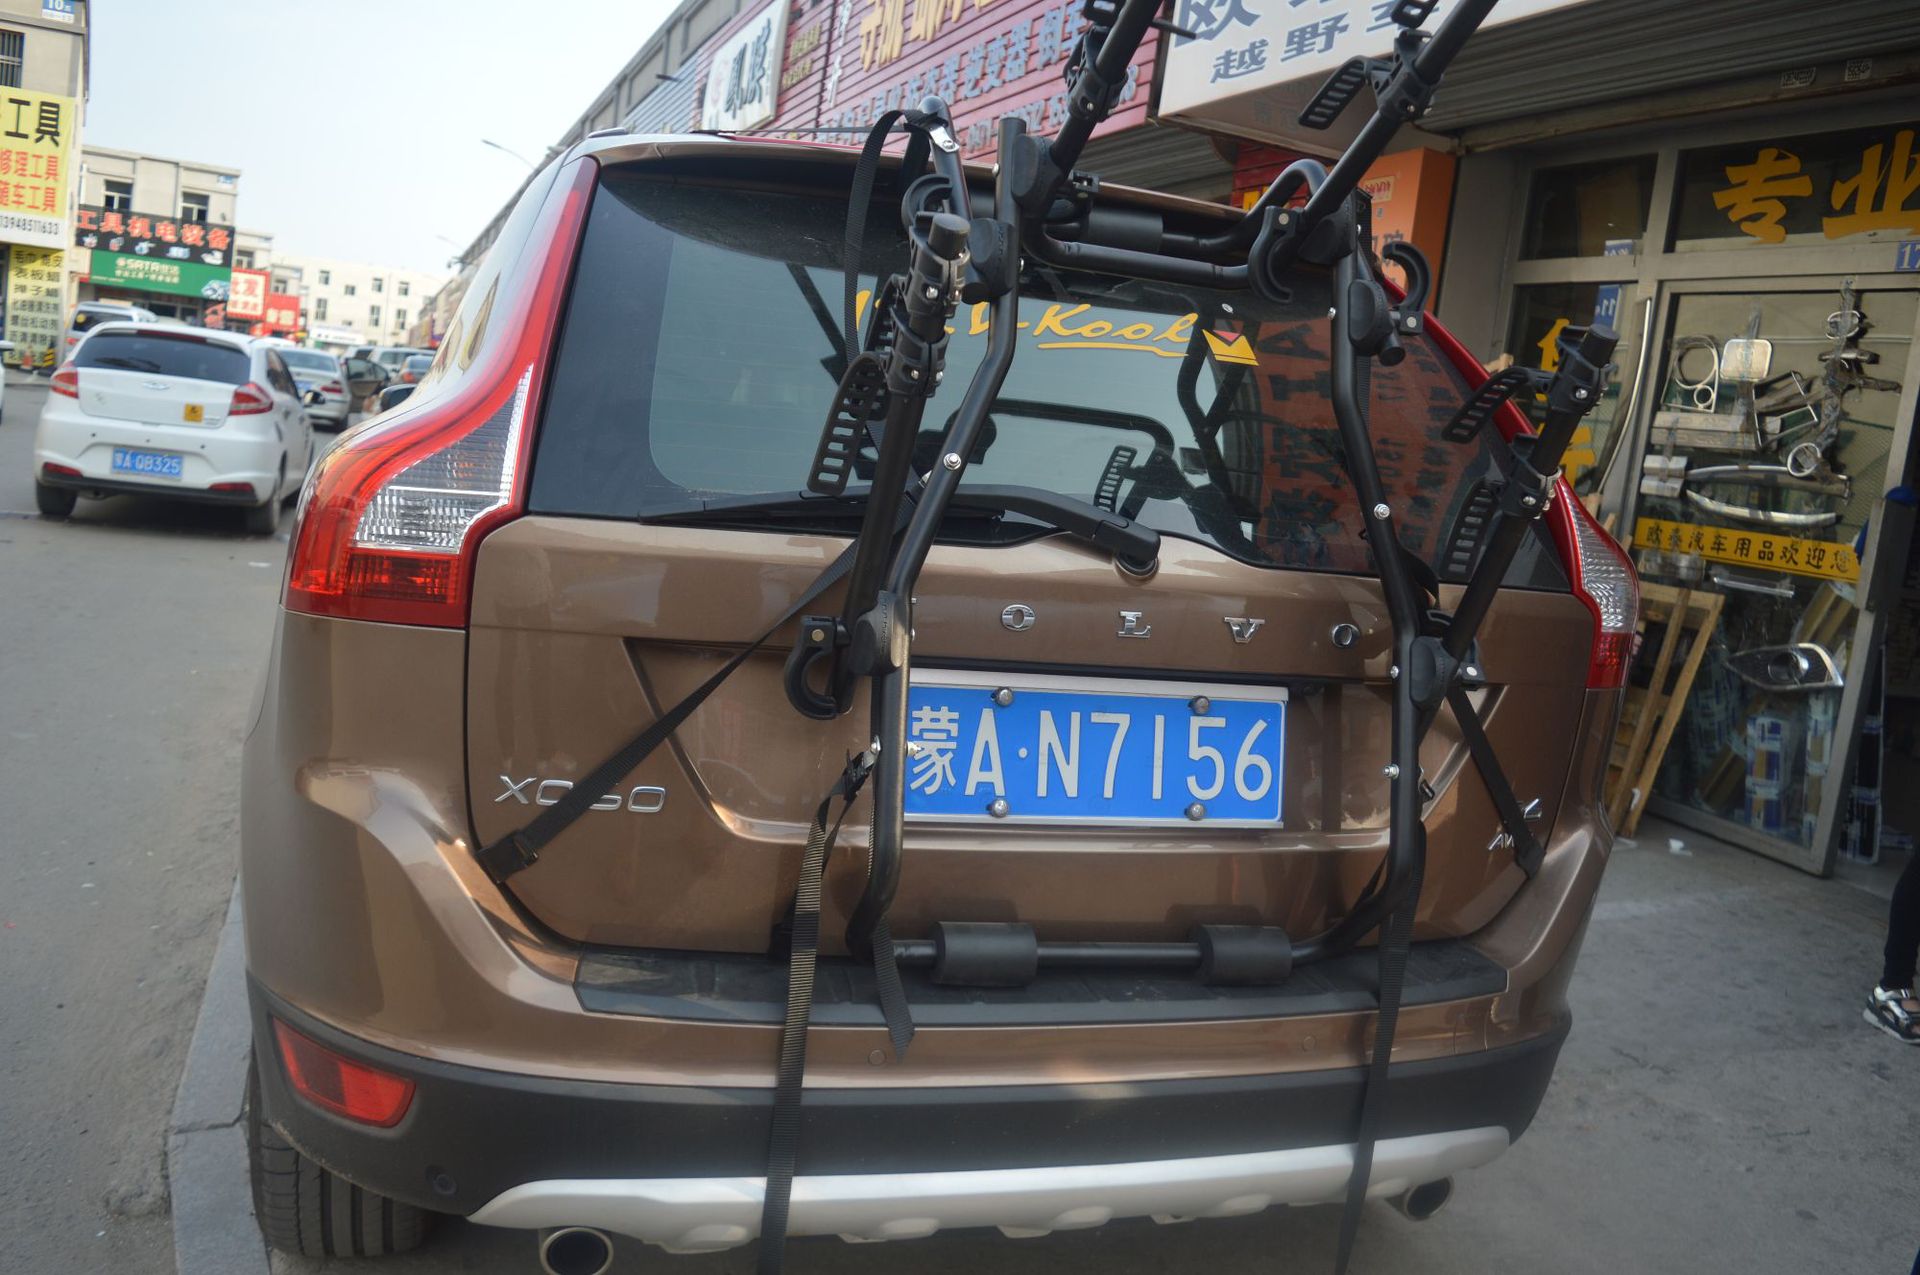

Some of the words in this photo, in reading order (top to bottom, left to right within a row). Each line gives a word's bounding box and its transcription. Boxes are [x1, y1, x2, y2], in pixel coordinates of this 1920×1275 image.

[4, 98, 60, 147] 工具
[74, 210, 231, 251] 工具机电设备
[1001, 603, 1359, 649] OLVO
[910, 705, 1273, 802] 蒙A·N7156
